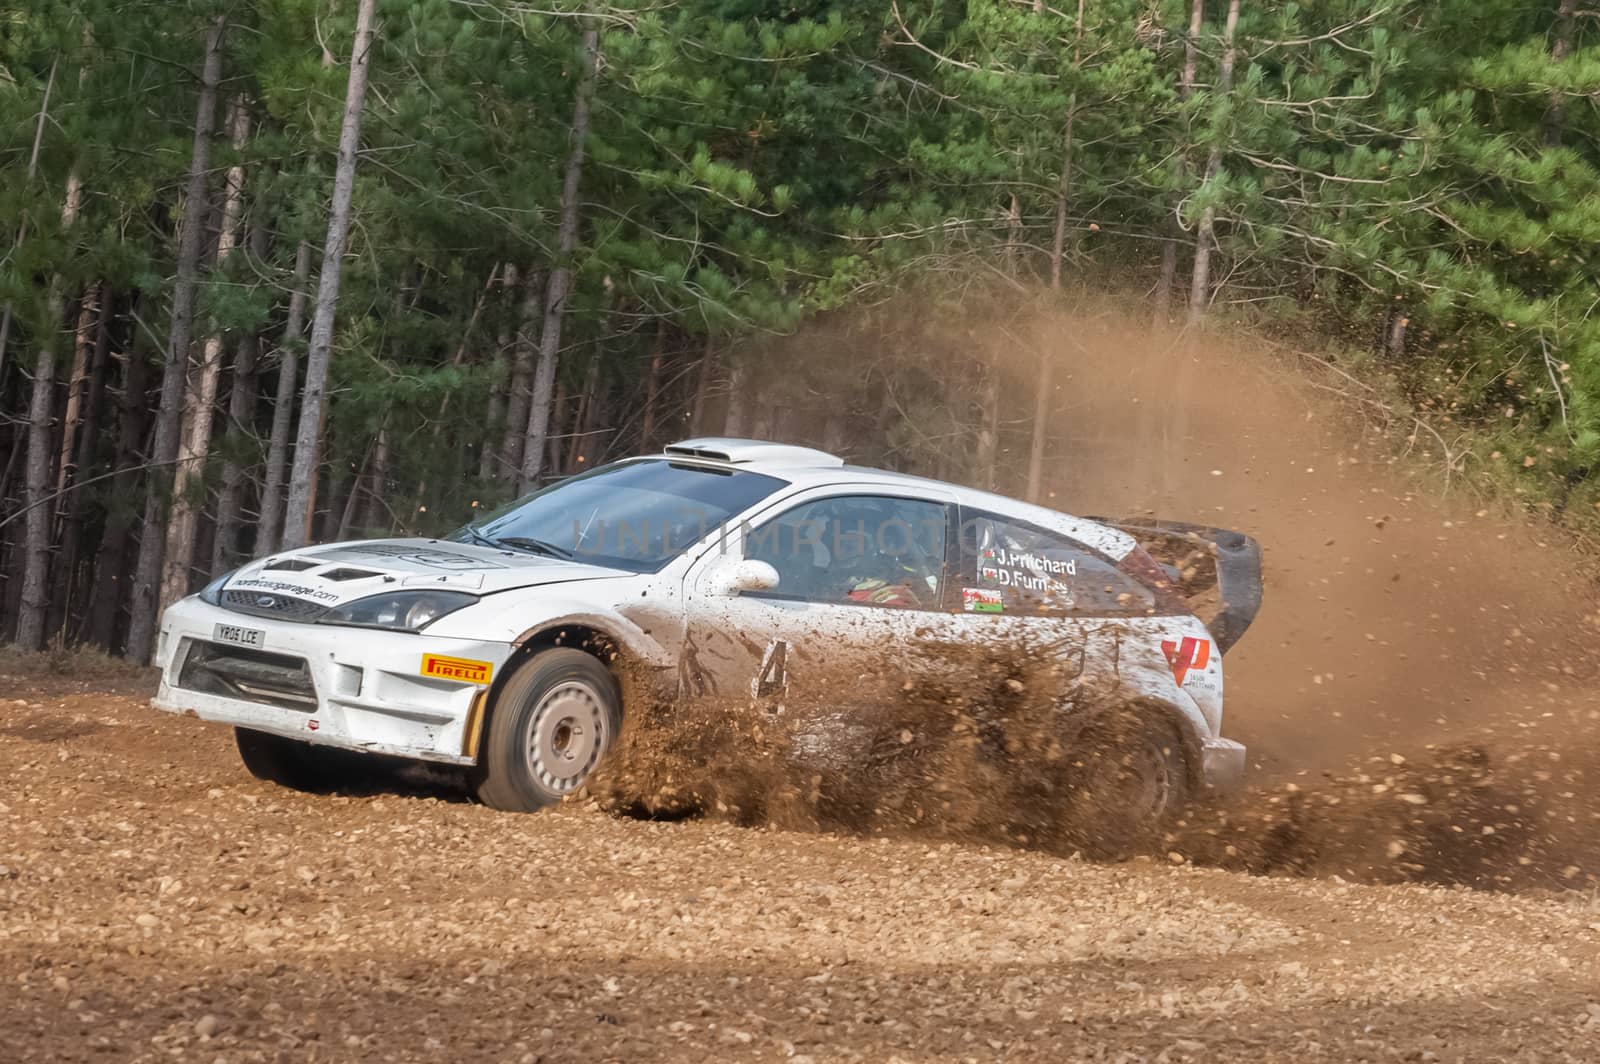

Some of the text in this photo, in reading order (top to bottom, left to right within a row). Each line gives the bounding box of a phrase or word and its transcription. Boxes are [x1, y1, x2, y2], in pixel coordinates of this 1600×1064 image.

[997, 548, 1076, 576] J.Pritchard
[241, 629, 258, 645] LCE
[427, 658, 487, 681] PIRELLI
[752, 637, 791, 715] 4
